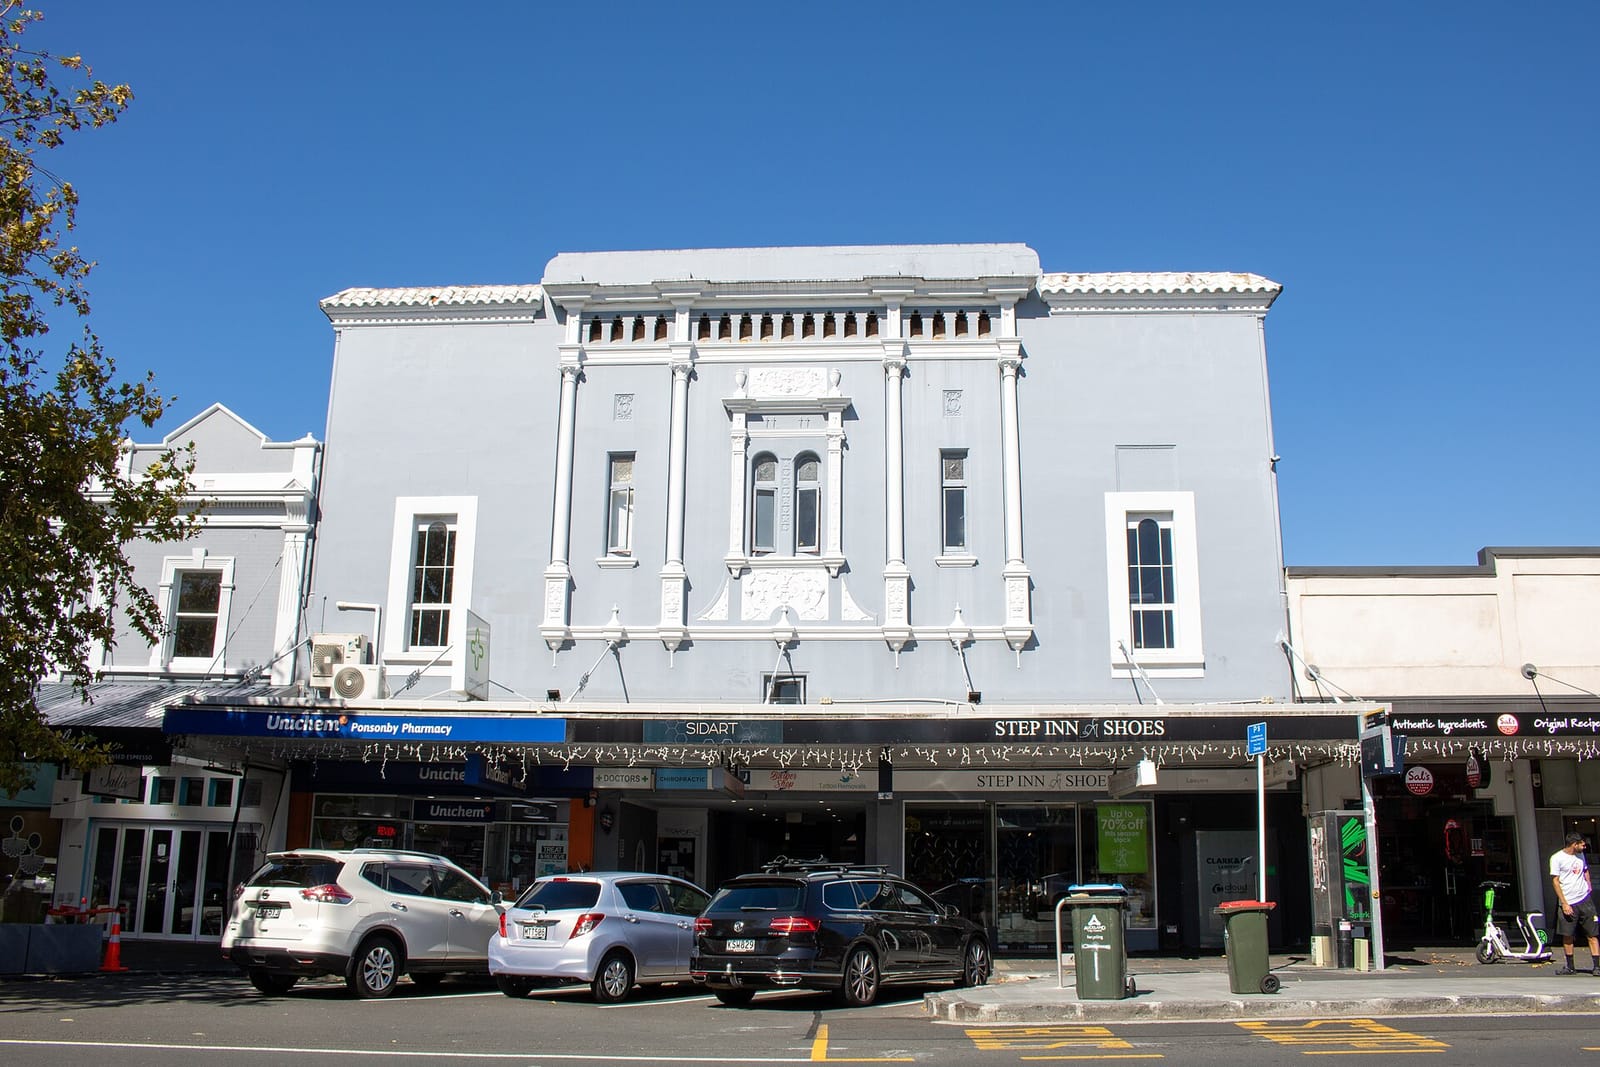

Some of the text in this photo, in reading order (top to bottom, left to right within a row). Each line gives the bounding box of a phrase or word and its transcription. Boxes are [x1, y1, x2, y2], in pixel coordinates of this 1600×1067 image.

[266, 714, 452, 735] Unichem Ponsonby Pharmacy
[686, 722, 738, 735] SIDART
[995, 719, 1165, 736] STEP INN SHOES
[1534, 718, 1568, 734] Original
[419, 767, 465, 781] Uniche
[603, 774, 641, 783] DOCTORS
[977, 774, 1015, 788] STEP
[1017, 775, 1045, 788] INN
[1408, 770, 1430, 781] Sal's
[429, 804, 486, 819] Unichem
[1110, 809, 1134, 819] Up to
